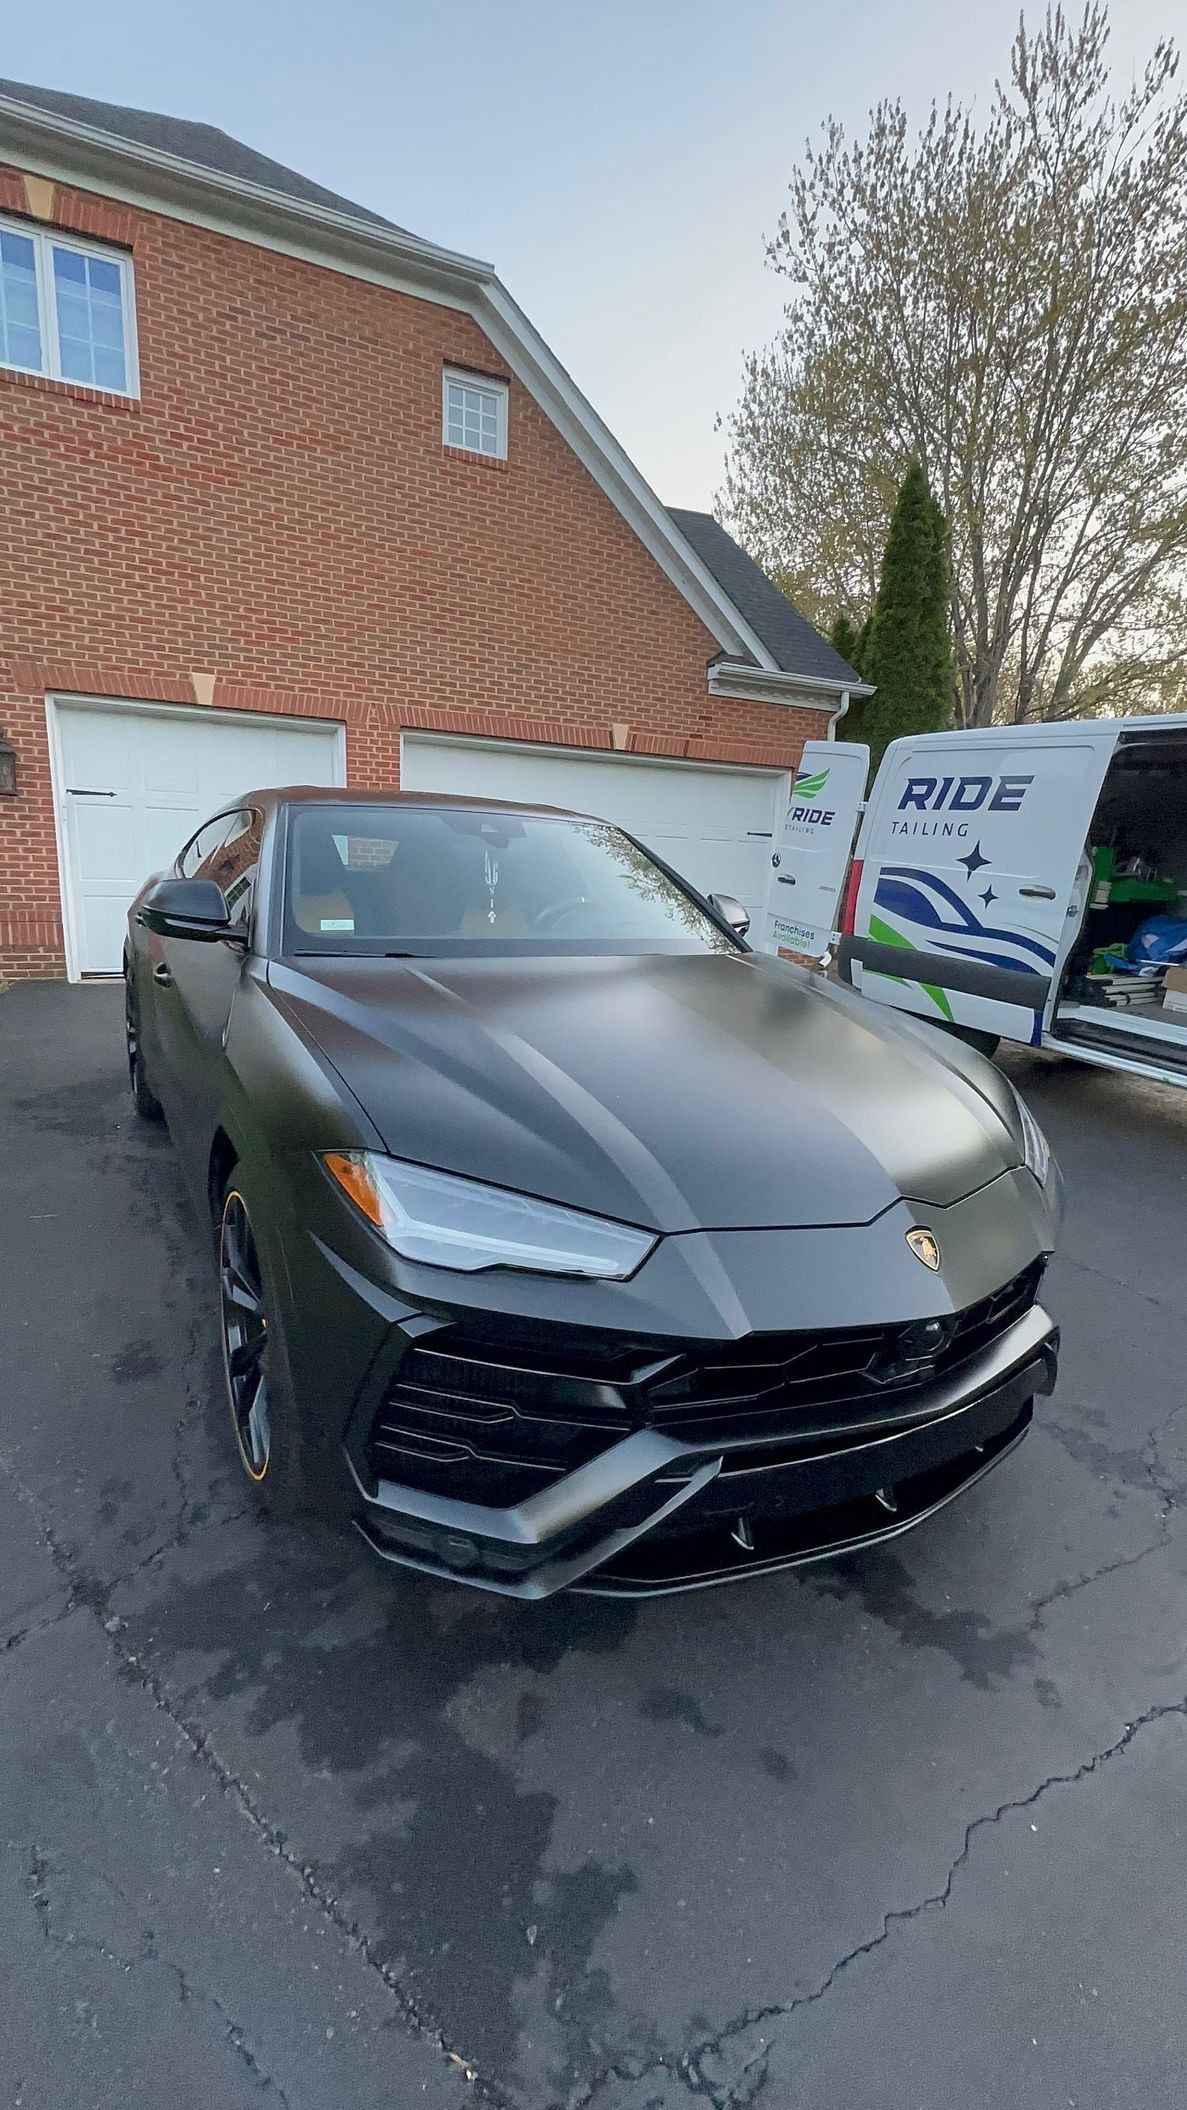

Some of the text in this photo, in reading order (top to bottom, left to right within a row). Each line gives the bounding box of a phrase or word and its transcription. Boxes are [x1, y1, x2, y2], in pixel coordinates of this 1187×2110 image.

[897, 775, 1035, 811] RIDE
[891, 821, 969, 837] TAILING
[774, 920, 815, 940] Franchises
[772, 931, 811, 949] Available!
